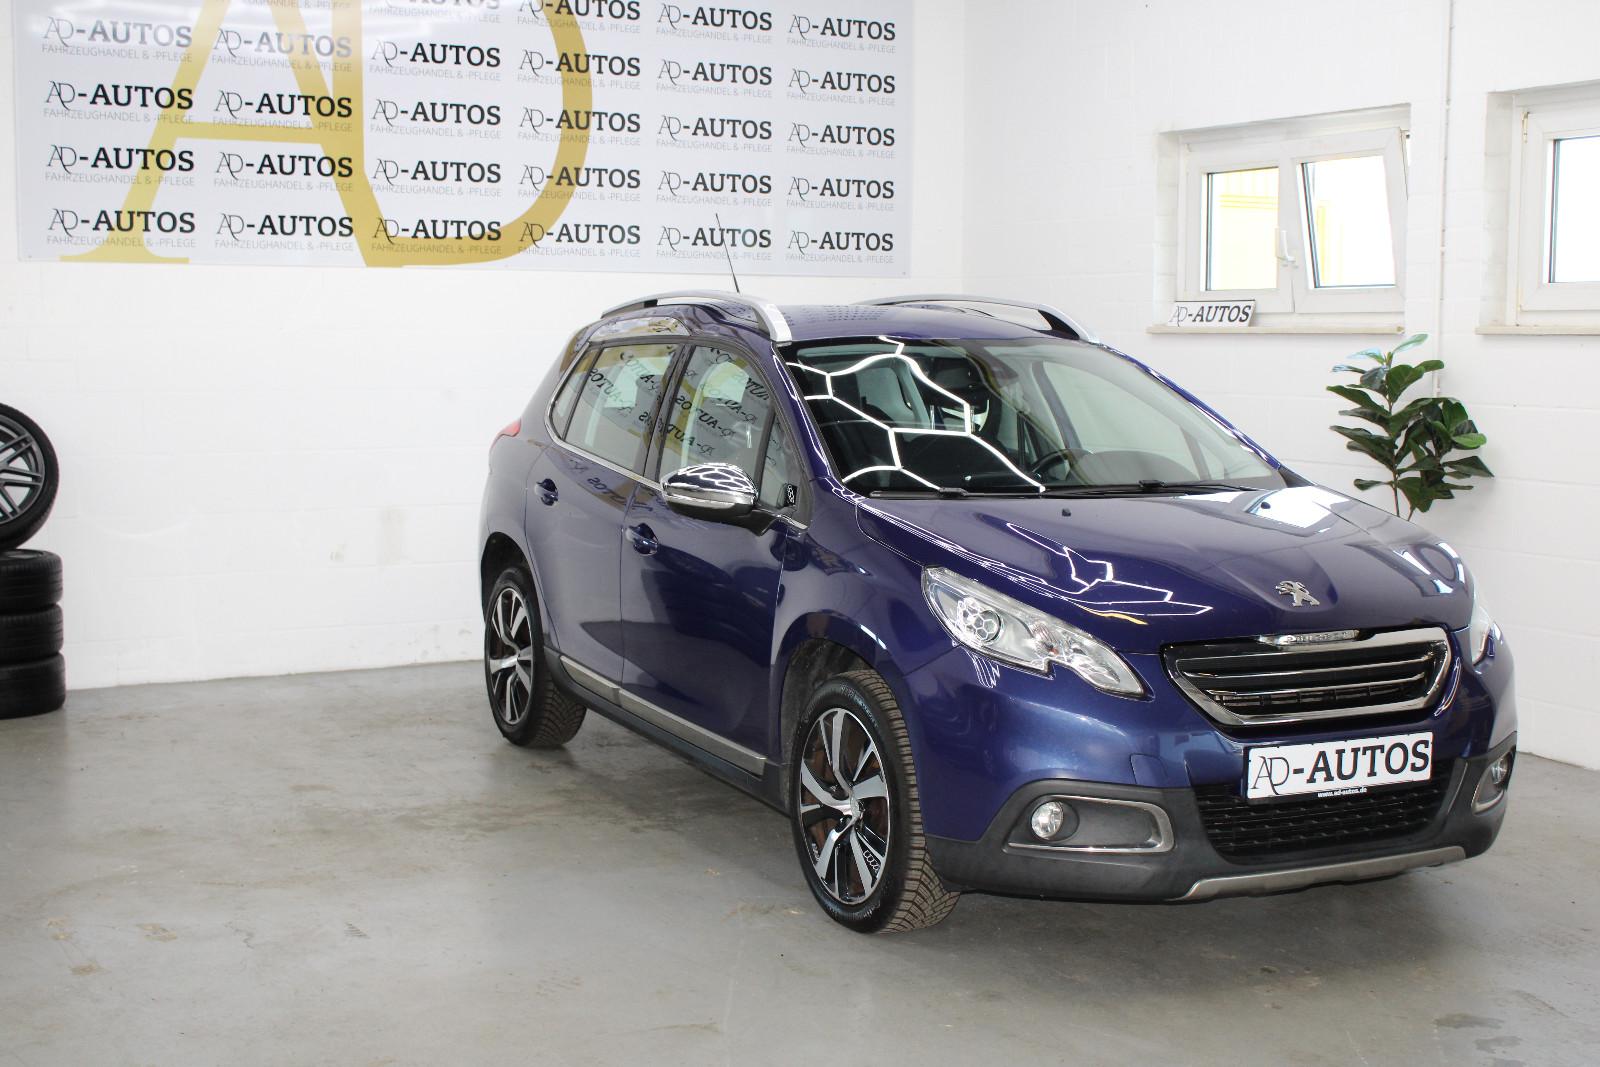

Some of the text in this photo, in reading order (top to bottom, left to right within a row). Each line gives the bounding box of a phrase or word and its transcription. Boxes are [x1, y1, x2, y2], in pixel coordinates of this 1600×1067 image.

[657, 3, 772, 31] AD-AUTOS
[789, 15, 896, 41] AD-AUTOS
[44, 17, 192, 48] AD-AUTOS
[214, 28, 352, 58] AD-AUTOS
[372, 41, 500, 68] AD-AUTOS
[520, 49, 641, 77] AD-AUTOS
[658, 59, 772, 85] AD-AUTOS
[789, 69, 895, 94] AD-AUTOS
[46, 81, 193, 111] AD-AUTOS
[214, 90, 352, 119] AD-AUTOS
[372, 100, 501, 127] AD-AUTOS
[520, 107, 641, 134] AD-AUTOS
[658, 115, 772, 141] AD-AUTOS
[788, 123, 895, 148] AD-AUTOS
[47, 145, 195, 174] AD-AUTOS
[216, 152, 353, 180] AD-AUTOS
[373, 159, 501, 186] AD-AUTOS
[520, 165, 641, 191] AD-AUTOS
[658, 171, 772, 196] AD-AUTOS
[788, 177, 895, 201] AD-AUTOS
[49, 209, 196, 237] AD-AUTOS
[216, 213, 354, 241] AD-AUTOS
[374, 218, 502, 244] AD-AUTOS
[520, 222, 641, 248] AD-AUTOS
[657, 226, 772, 251] AD-AUTOS
[788, 231, 894, 255] AD-AUTOS
[1168, 305, 1252, 327] AD-AUTOS
[1251, 740, 1429, 795] AD-AUTOS
